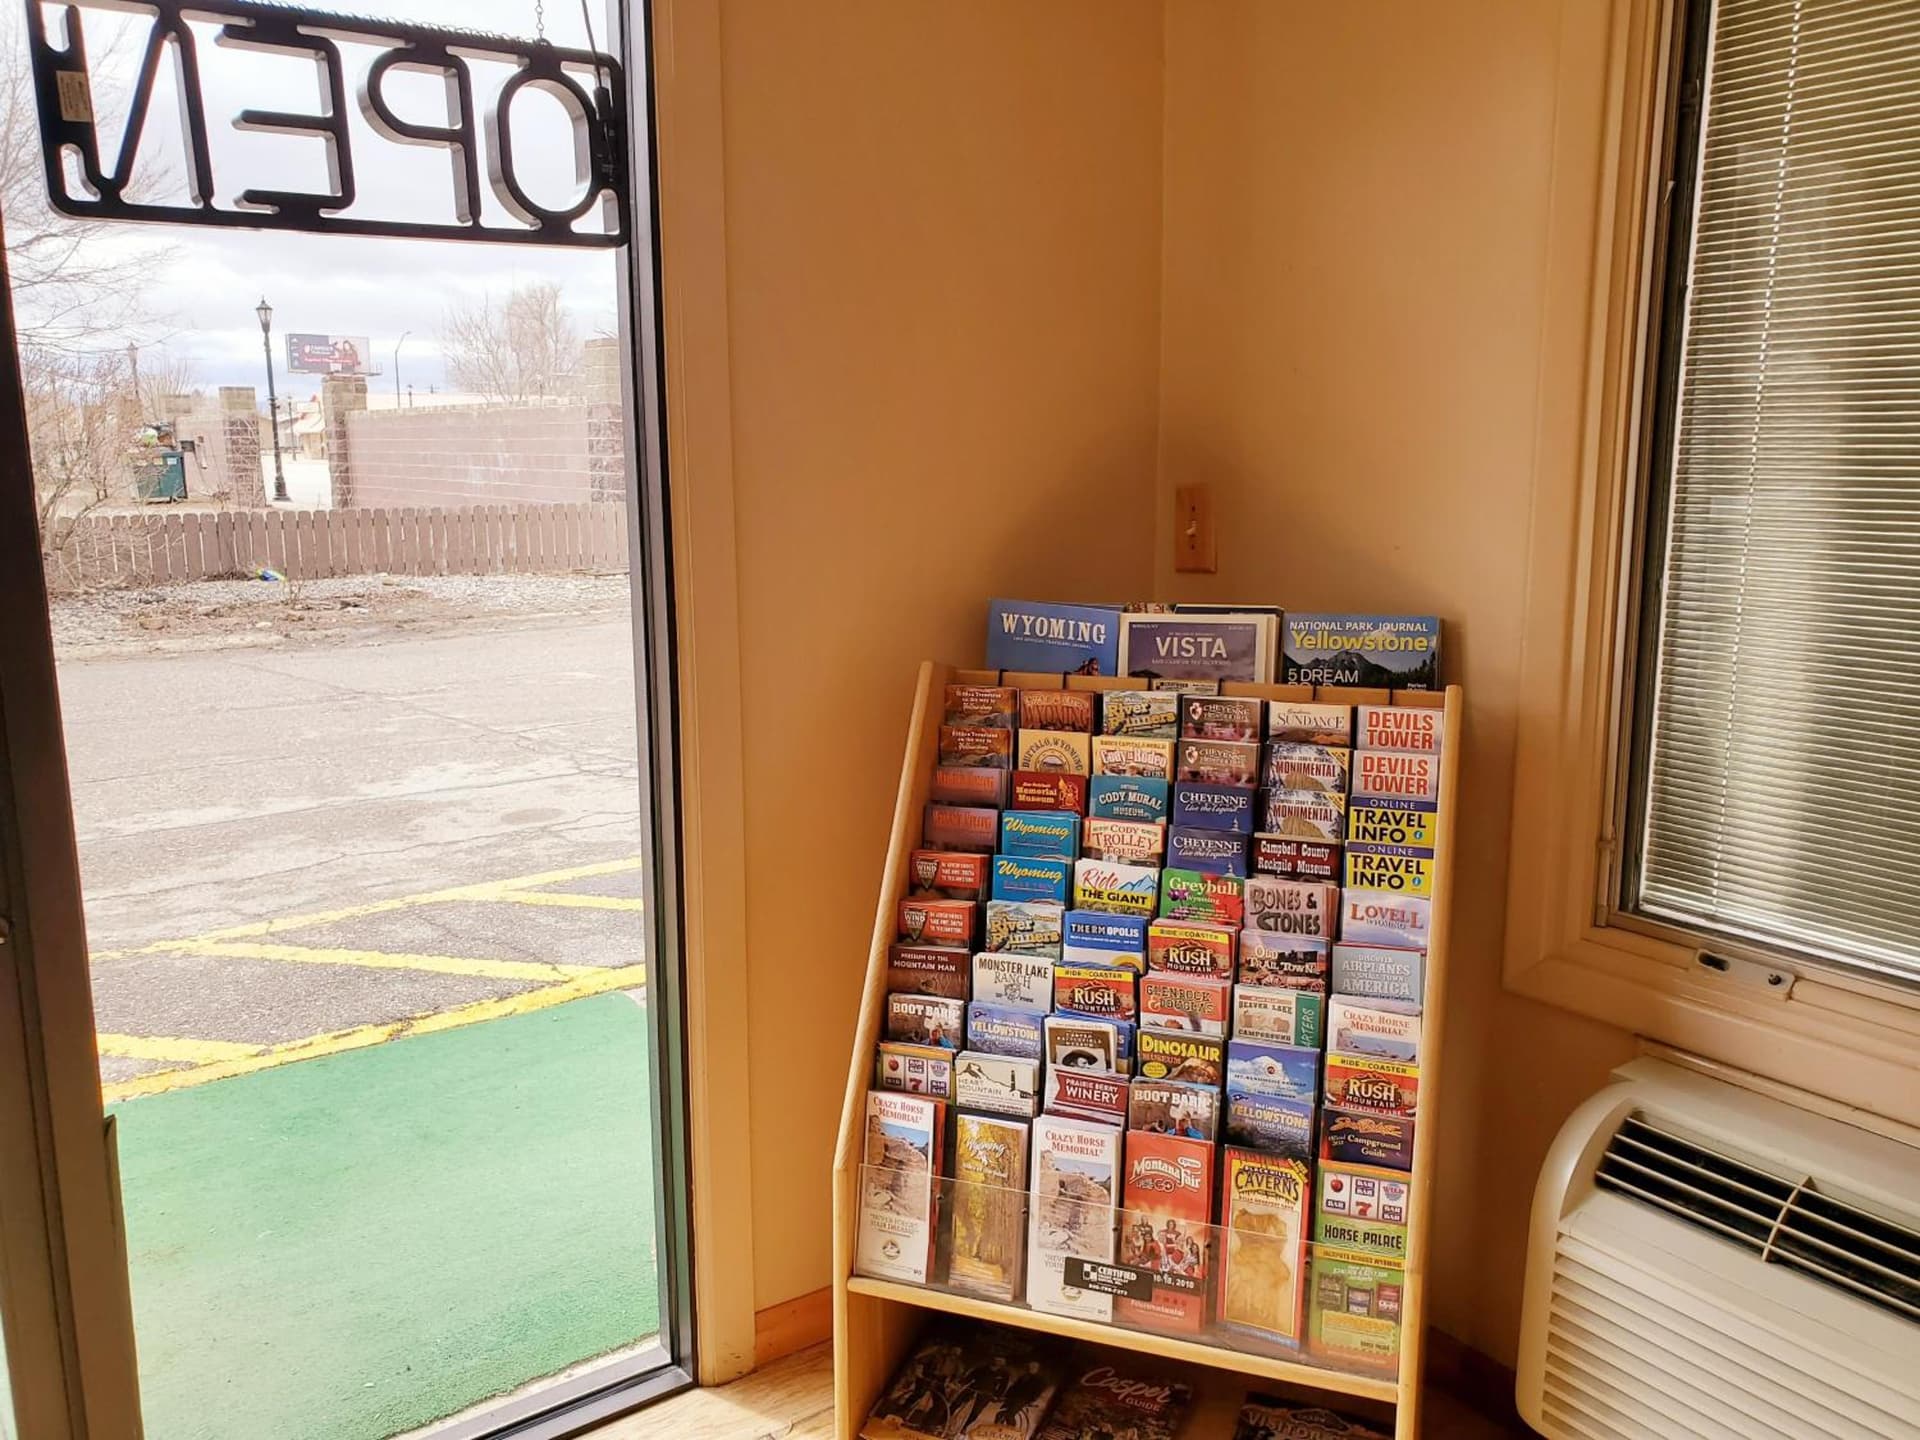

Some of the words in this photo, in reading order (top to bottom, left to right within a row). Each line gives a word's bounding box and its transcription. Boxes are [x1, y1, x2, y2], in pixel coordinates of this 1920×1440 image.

[1001, 612, 1106, 645] WYOMING
[1289, 621, 1343, 631] NATIONAL
[1346, 622, 1373, 631] PARK
[1378, 622, 1428, 632] JOURNAL
[1156, 636, 1227, 658] VISTA
[1291, 630, 1428, 651] Yellowstone
[1288, 668, 1298, 682] 5
[1301, 669, 1359, 684] DREAM
[1108, 703, 1150, 718] River
[1203, 704, 1249, 715] CHEYENNE
[1108, 712, 1176, 730] Runners
[1276, 713, 1345, 729] SUNDANCE
[1368, 711, 1433, 731] DEVILS
[1367, 729, 1433, 749] TOWER
[1053, 738, 1084, 771] WYOMING
[1101, 750, 1126, 765] Cody
[1134, 749, 1167, 767] Rodeo
[1200, 749, 1246, 761] CHEYENNE
[1275, 761, 1337, 778] MONUMENTAL
[1363, 756, 1428, 776] DEVILS
[1016, 787, 1057, 797] Memorial
[1361, 774, 1428, 795] TOWER
[1018, 794, 1054, 803] Museum
[1099, 791, 1127, 805] CODY
[1128, 791, 1162, 810] MURAL
[1179, 791, 1248, 809] CHEYENNE
[1370, 800, 1417, 810] ONLINE
[1112, 806, 1145, 817] MUSEUM
[1273, 805, 1333, 822] MONUMENTAL
[1354, 809, 1427, 829] TRAVEL
[1004, 817, 1071, 841] Wyoming
[1110, 824, 1139, 834] CODY
[1355, 825, 1406, 843] INFO
[1092, 832, 1159, 850] TROLLEY
[1173, 836, 1242, 854] CHEYENNE
[1103, 846, 1150, 859] TOURS
[1260, 840, 1297, 856] Campbell
[1301, 844, 1330, 860] County
[1367, 844, 1414, 856] ONLINE
[917, 861, 937, 872] WIND
[997, 861, 1064, 883] Wyoming
[1258, 857, 1292, 873] Rockpile
[1296, 861, 1331, 876] Museum
[1351, 855, 1425, 875] TRAVEL
[1082, 868, 1119, 889] Ride
[1169, 877, 1238, 896] Greybull
[1353, 872, 1404, 890] INFO
[1081, 889, 1105, 900] THE
[1108, 892, 1148, 904] GIANT
[1250, 885, 1300, 915] BONES
[1306, 892, 1317, 909] &
[904, 911, 926, 923] WIND
[1351, 903, 1424, 929] LOVELL
[1366, 919, 1407, 930] WYOMING
[991, 918, 1034, 932] River
[1071, 923, 1139, 938] THERMOPOLIS
[992, 931, 1060, 947] Runners
[1169, 948, 1211, 966] RUSH
[1255, 946, 1278, 960] OLD
[893, 960, 936, 971] MOUNTAIN
[978, 958, 1022, 974] MONSTER
[1025, 964, 1049, 979] LAKE
[1167, 962, 1212, 972] MOUNTAIN
[1247, 957, 1281, 971] TRAIL
[1283, 962, 1315, 974] TOWN
[1342, 960, 1411, 976] AIRPLANES
[994, 971, 1032, 990] RANCH
[1343, 979, 1410, 996] AMERICA
[1073, 988, 1116, 1005] RUSH
[1146, 985, 1212, 1002] GLENROCK
[893, 1002, 924, 1016] BOOT
[1073, 1003, 1117, 1012] MOUNTAIN
[1160, 999, 1215, 1013] DOUGLAS
[1239, 1000, 1269, 1010] BEAVER
[1272, 1004, 1293, 1015] LAKE
[1344, 1010, 1374, 1022] CRAZY
[1378, 1014, 1411, 1029] HORSE
[1351, 1020, 1405, 1036] MEMORIAL
[970, 1021, 1040, 1041] YELLOWSTONE
[1238, 1029, 1291, 1042] CAMPGROUND
[1142, 1034, 1220, 1062] DINOSAUR
[1368, 1063, 1407, 1073] COASTER
[909, 1077, 922, 1091] 7
[959, 1084, 1002, 1096] MOUNTAIN
[1066, 1078, 1094, 1089] PRAIRIE
[1095, 1082, 1118, 1093] BERRY
[1348, 1079, 1396, 1101] RUSH
[1066, 1086, 1119, 1105] WINERY
[1135, 1090, 1170, 1103] BOOT
[1346, 1096, 1396, 1108] MOUNTAIN
[873, 1096, 897, 1109] CRAZY
[901, 1101, 924, 1114] HORSE
[879, 1108, 920, 1124] MEMORIAL
[1231, 1104, 1310, 1128] YELLOWSTONE
[1045, 1132, 1073, 1143] CRAZY
[1077, 1135, 1106, 1147] HORSE
[1347, 1135, 1401, 1151] Campground
[1052, 1143, 1100, 1157] MEMORIAL
[1361, 1147, 1387, 1158] Guide
[1131, 1157, 1182, 1184] Montana
[1181, 1168, 1202, 1190] Fair
[1235, 1170, 1299, 1201] CAVERNS
[1383, 1186, 1404, 1195] WILD
[1355, 1201, 1372, 1216] 7
[1325, 1224, 1359, 1242] HORSE
[1363, 1232, 1402, 1249] PALACE
[1098, 1266, 1137, 1281] CERTIFIED
[1081, 1367, 1171, 1402] Casper
[1126, 1398, 1160, 1412] GUIDE
[1248, 1410, 1322, 1440] VISITOR
